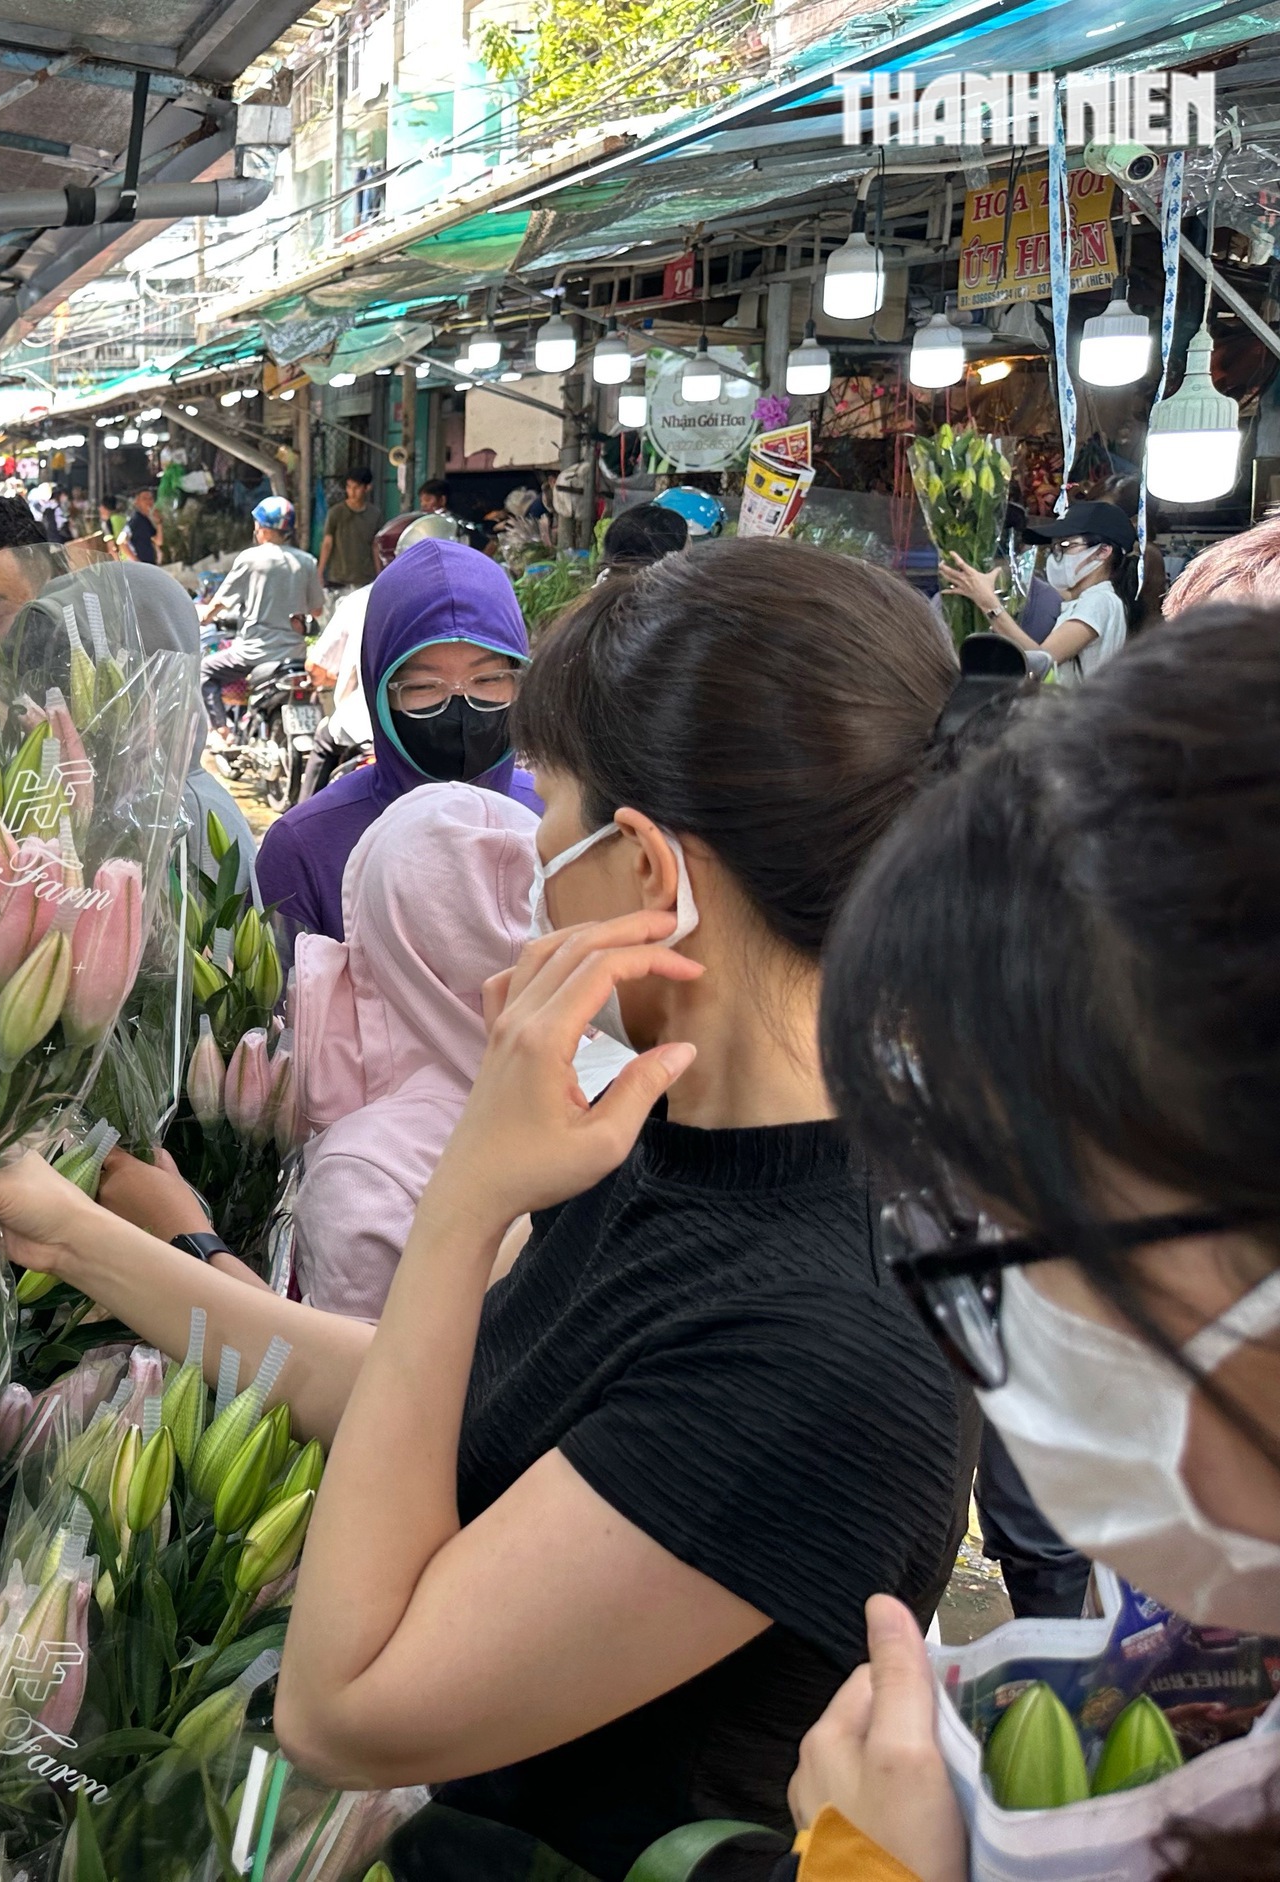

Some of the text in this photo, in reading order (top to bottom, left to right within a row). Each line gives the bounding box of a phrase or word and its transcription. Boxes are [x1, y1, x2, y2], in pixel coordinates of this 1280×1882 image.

[972, 185, 1029, 221] HOA
[963, 236, 1005, 289] ÚT
[661, 413, 746, 430] Nhận Gói Hoa
